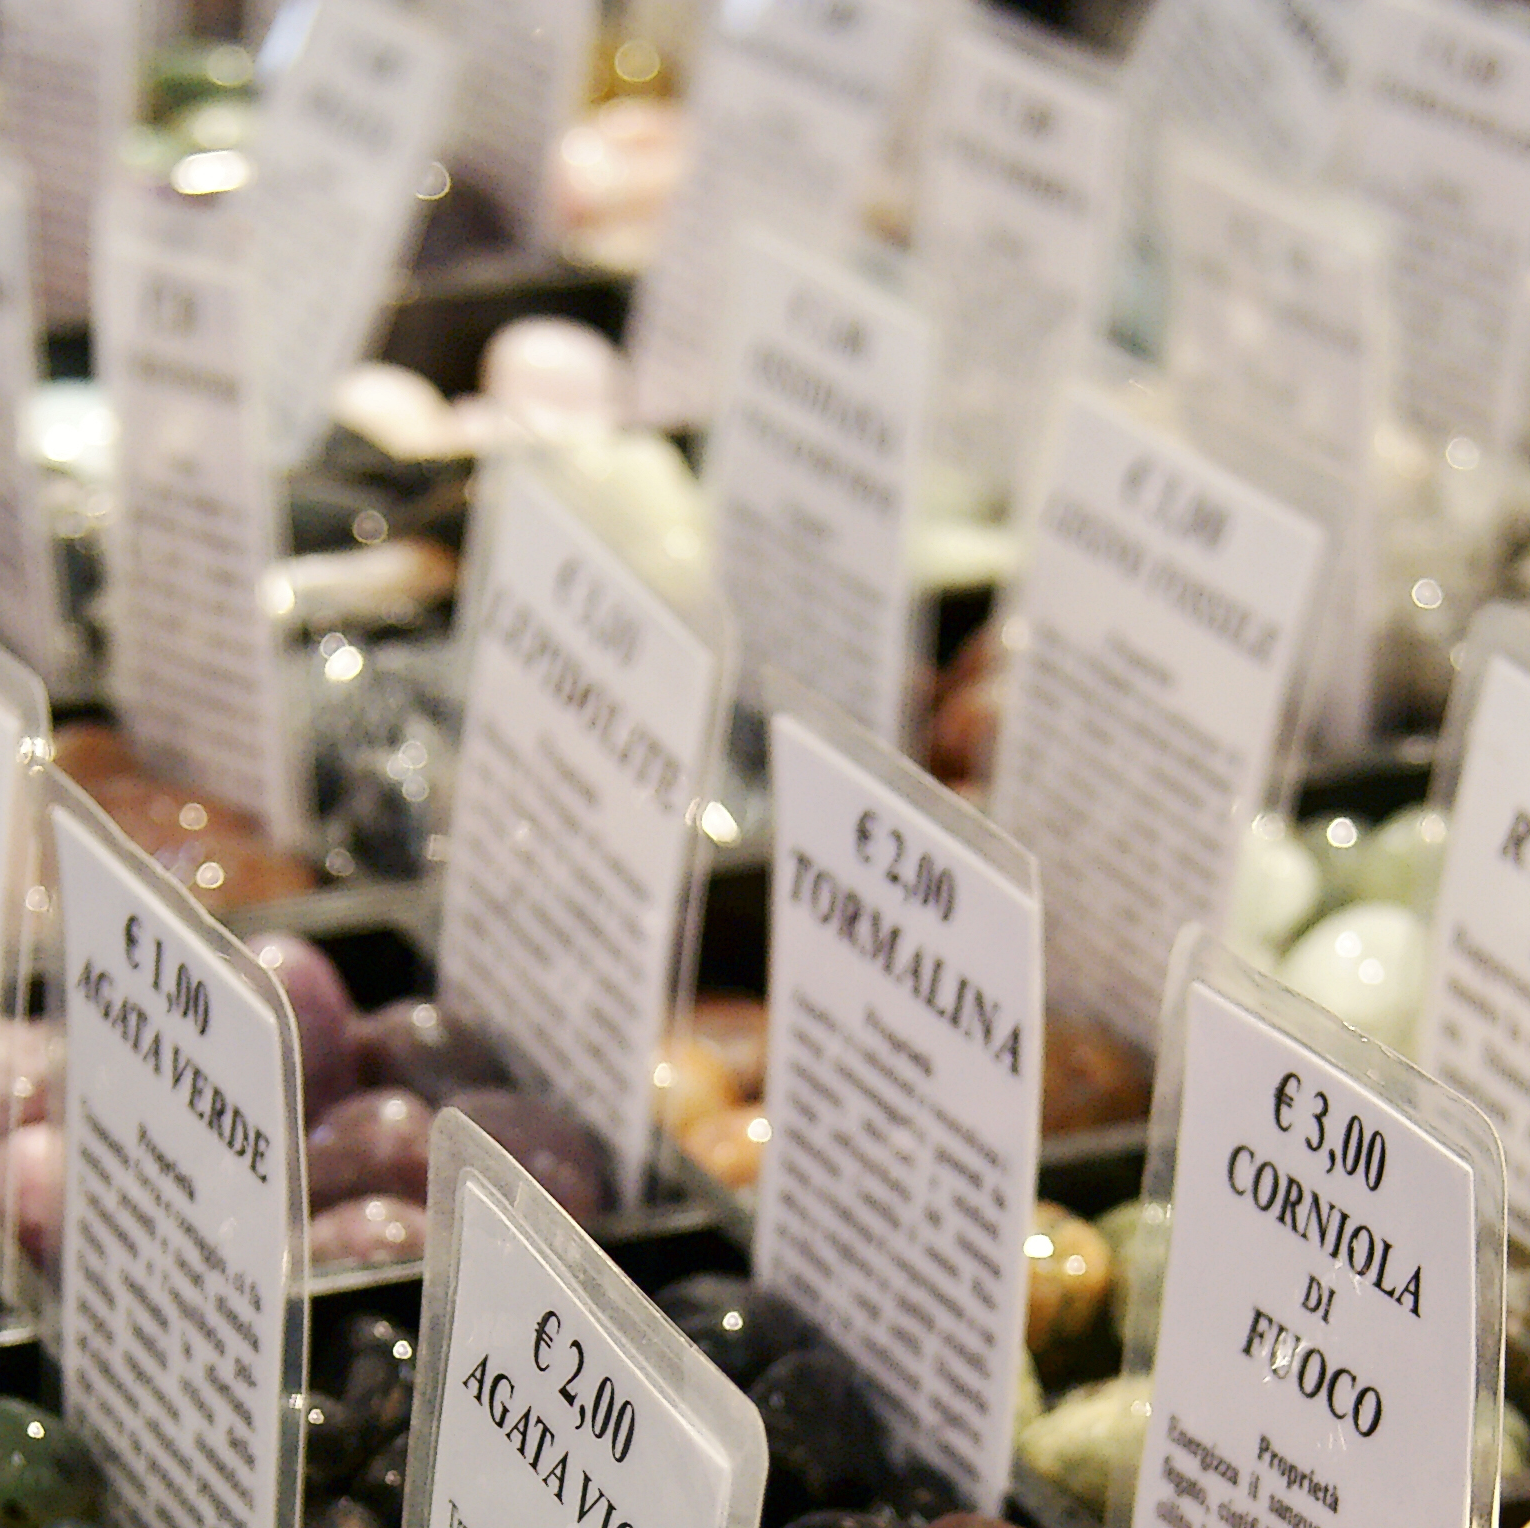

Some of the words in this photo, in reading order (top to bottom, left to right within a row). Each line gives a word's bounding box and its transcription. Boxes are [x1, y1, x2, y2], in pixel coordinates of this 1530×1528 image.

[853, 808, 878, 864] €
[883, 827, 957, 923] 2,00
[123, 913, 141, 971] €
[150, 937, 211, 1038] 1,00
[789, 849, 1022, 1077] TORMALINA
[75, 958, 162, 1076] AGATA
[170, 1044, 271, 1185] VERDE
[1272, 1070, 1302, 1133] €
[1303, 1089, 1387, 1193] 3,00
[1226, 1143, 1422, 1319] CORNIOLA
[1300, 1273, 1337, 1325] DI
[461, 1352, 569, 1506] AGATA
[532, 1308, 562, 1373] €
[557, 1337, 636, 1464] 2,00
[1240, 1306, 1383, 1439] FUOCO
[1246, 1471, 1261, 1502] il
[1255, 1433, 1340, 1515] Proprietà
